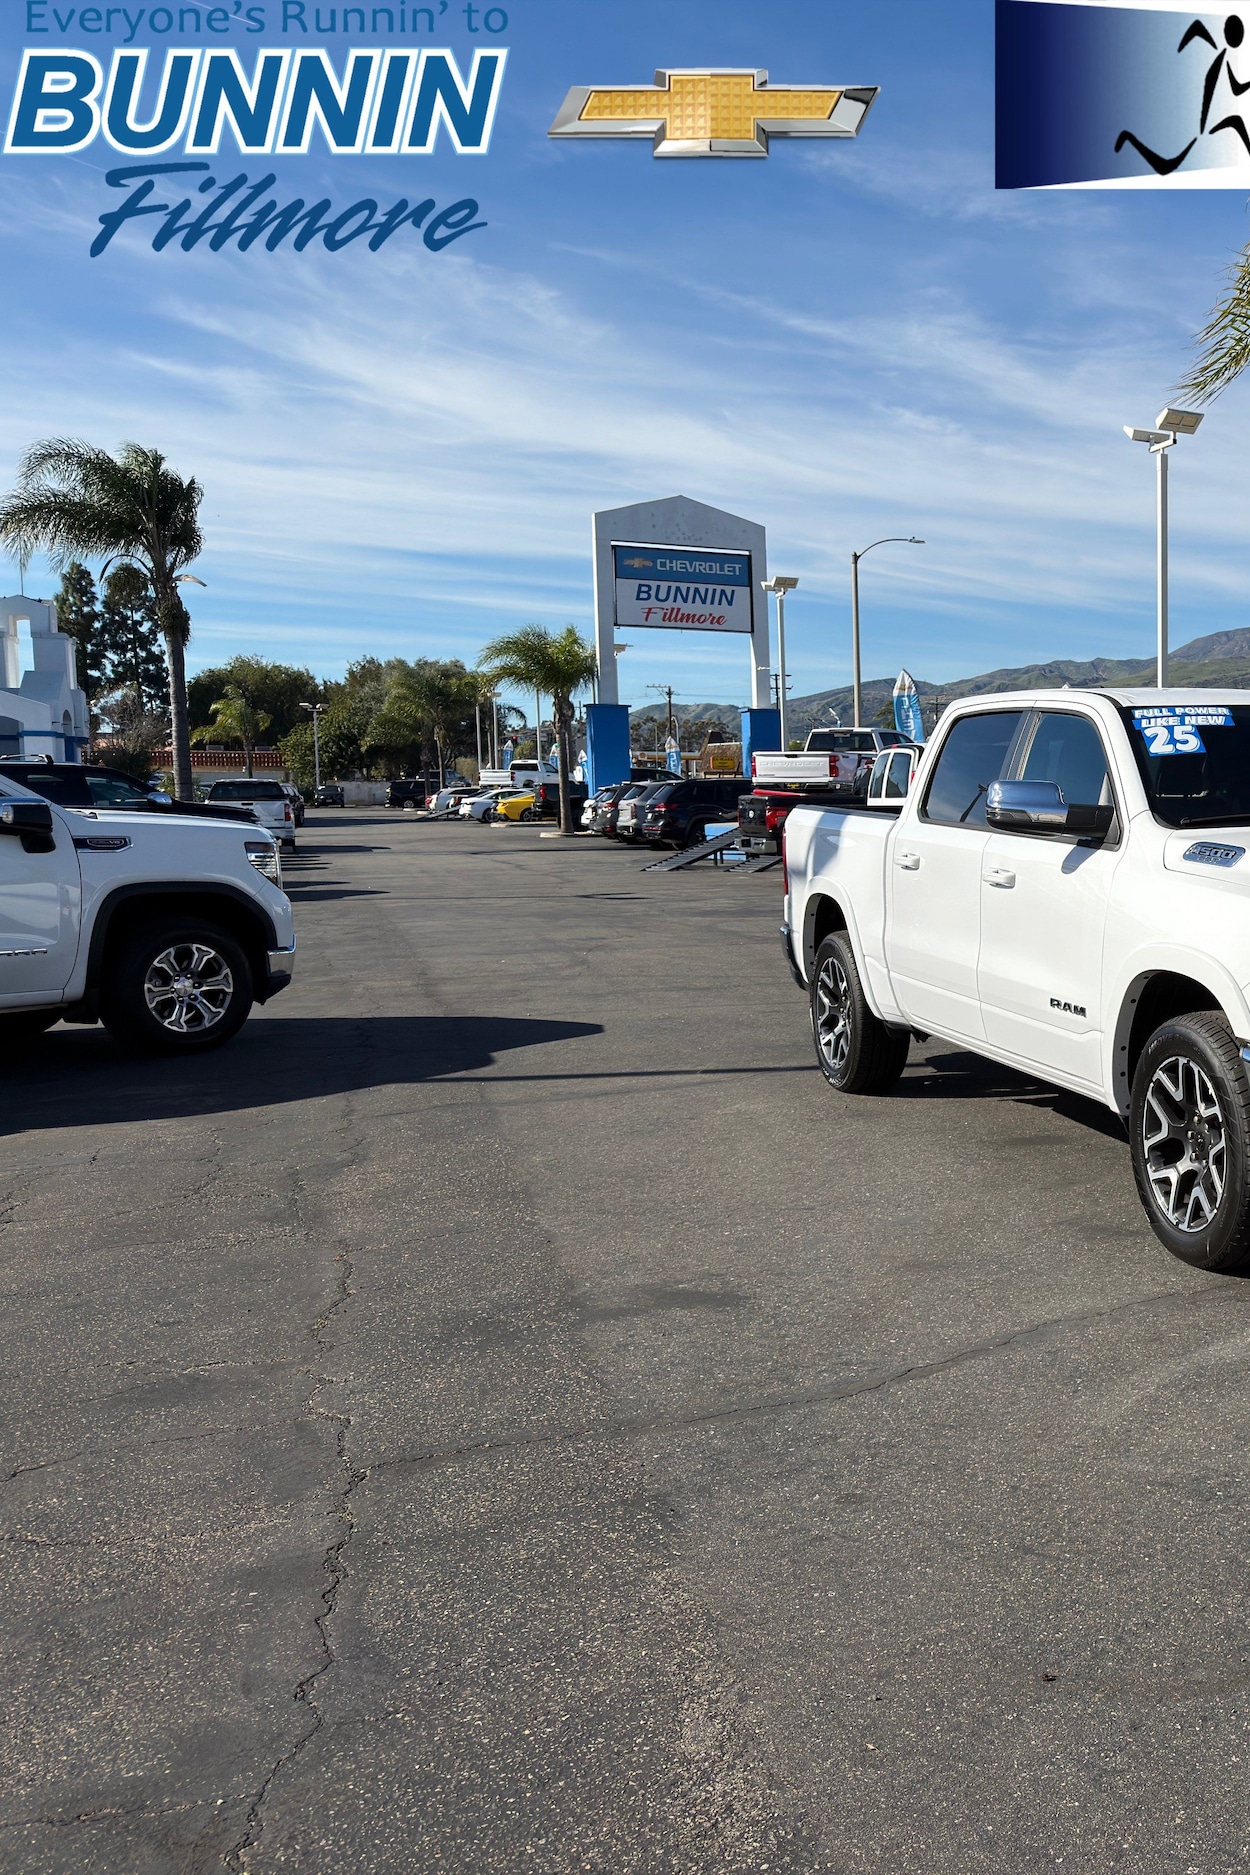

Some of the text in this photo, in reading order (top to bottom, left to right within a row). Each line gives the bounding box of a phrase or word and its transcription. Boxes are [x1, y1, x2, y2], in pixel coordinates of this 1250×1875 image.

[656, 558, 742, 576] CHEVROLET
[636, 583, 735, 606] BUNNIN
[641, 607, 727, 626] Fillmore
[1134, 707, 1230, 718] FULL POWER
[1141, 716, 1226, 728] LIKE NEW
[1144, 725, 1200, 755] 25
[1050, 997, 1087, 1018] RAM
